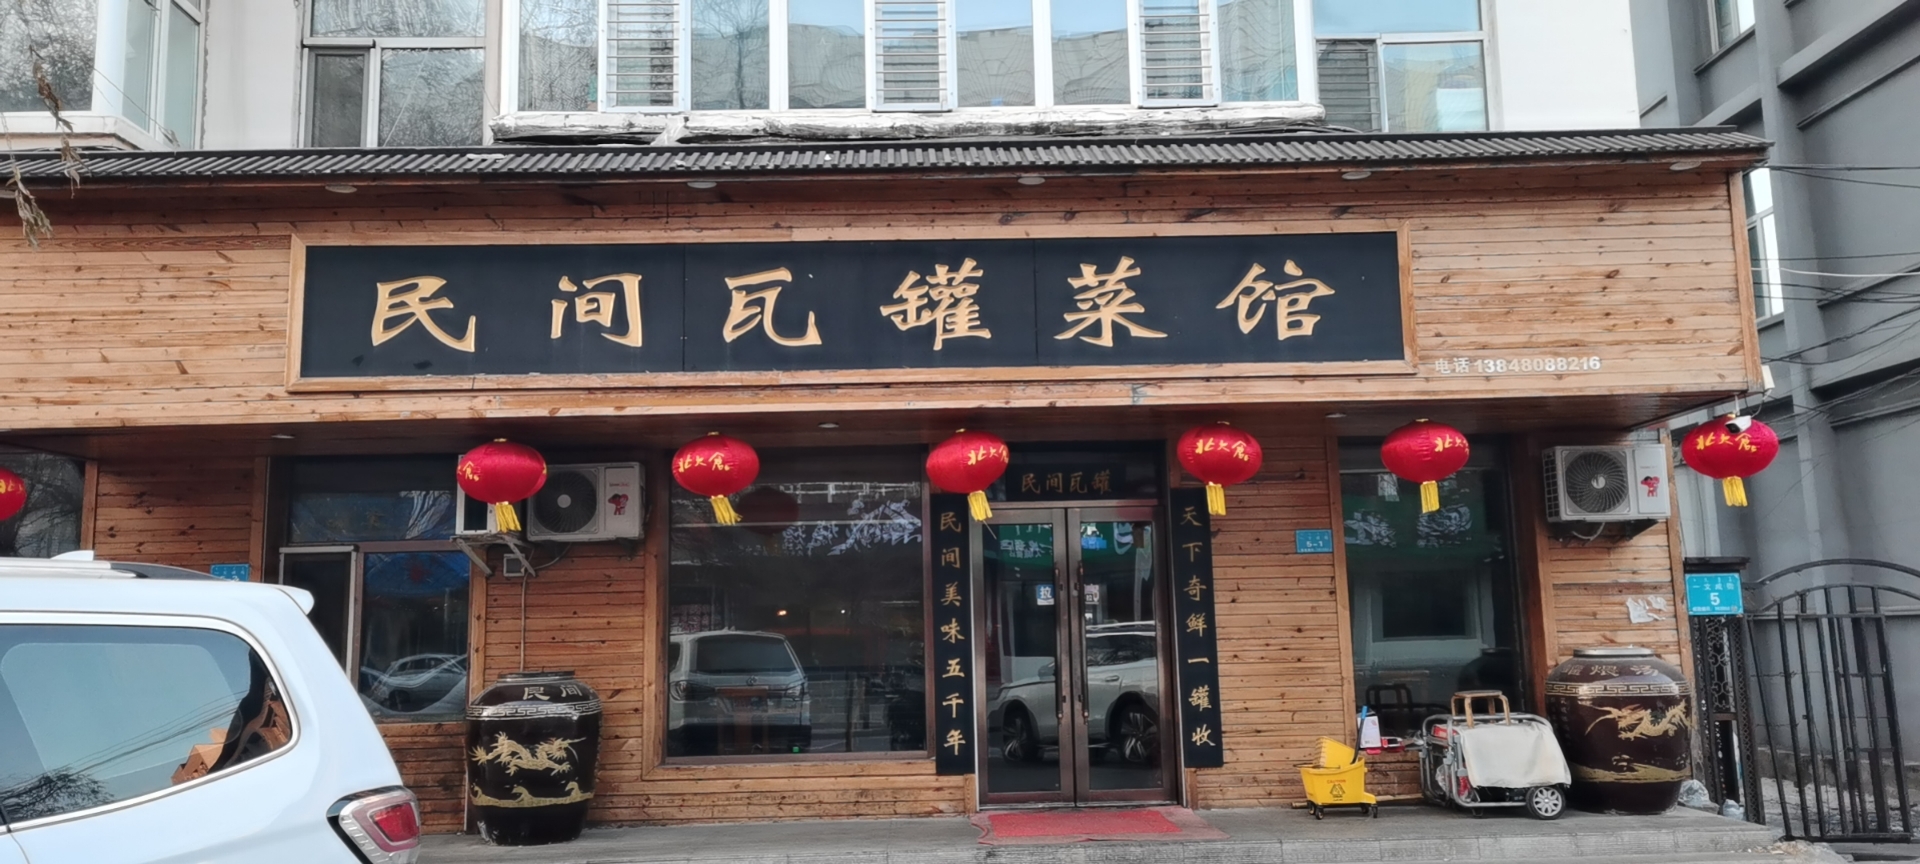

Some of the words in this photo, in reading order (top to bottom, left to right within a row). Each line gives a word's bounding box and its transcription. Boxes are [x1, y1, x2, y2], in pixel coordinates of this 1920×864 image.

[370, 255, 1336, 352] 民间瓦罐菜馆
[1435, 356, 1470, 374] 电话
[1474, 355, 1601, 373] 13848088216
[1021, 469, 1112, 495] 民间瓦罐
[1039, 586, 1052, 599] 拉
[1710, 592, 1721, 606] 5
[940, 511, 966, 756] 民间美味五千年
[1180, 506, 1216, 747] 天下奇鲜一罐收
[522, 684, 583, 701] 民间
